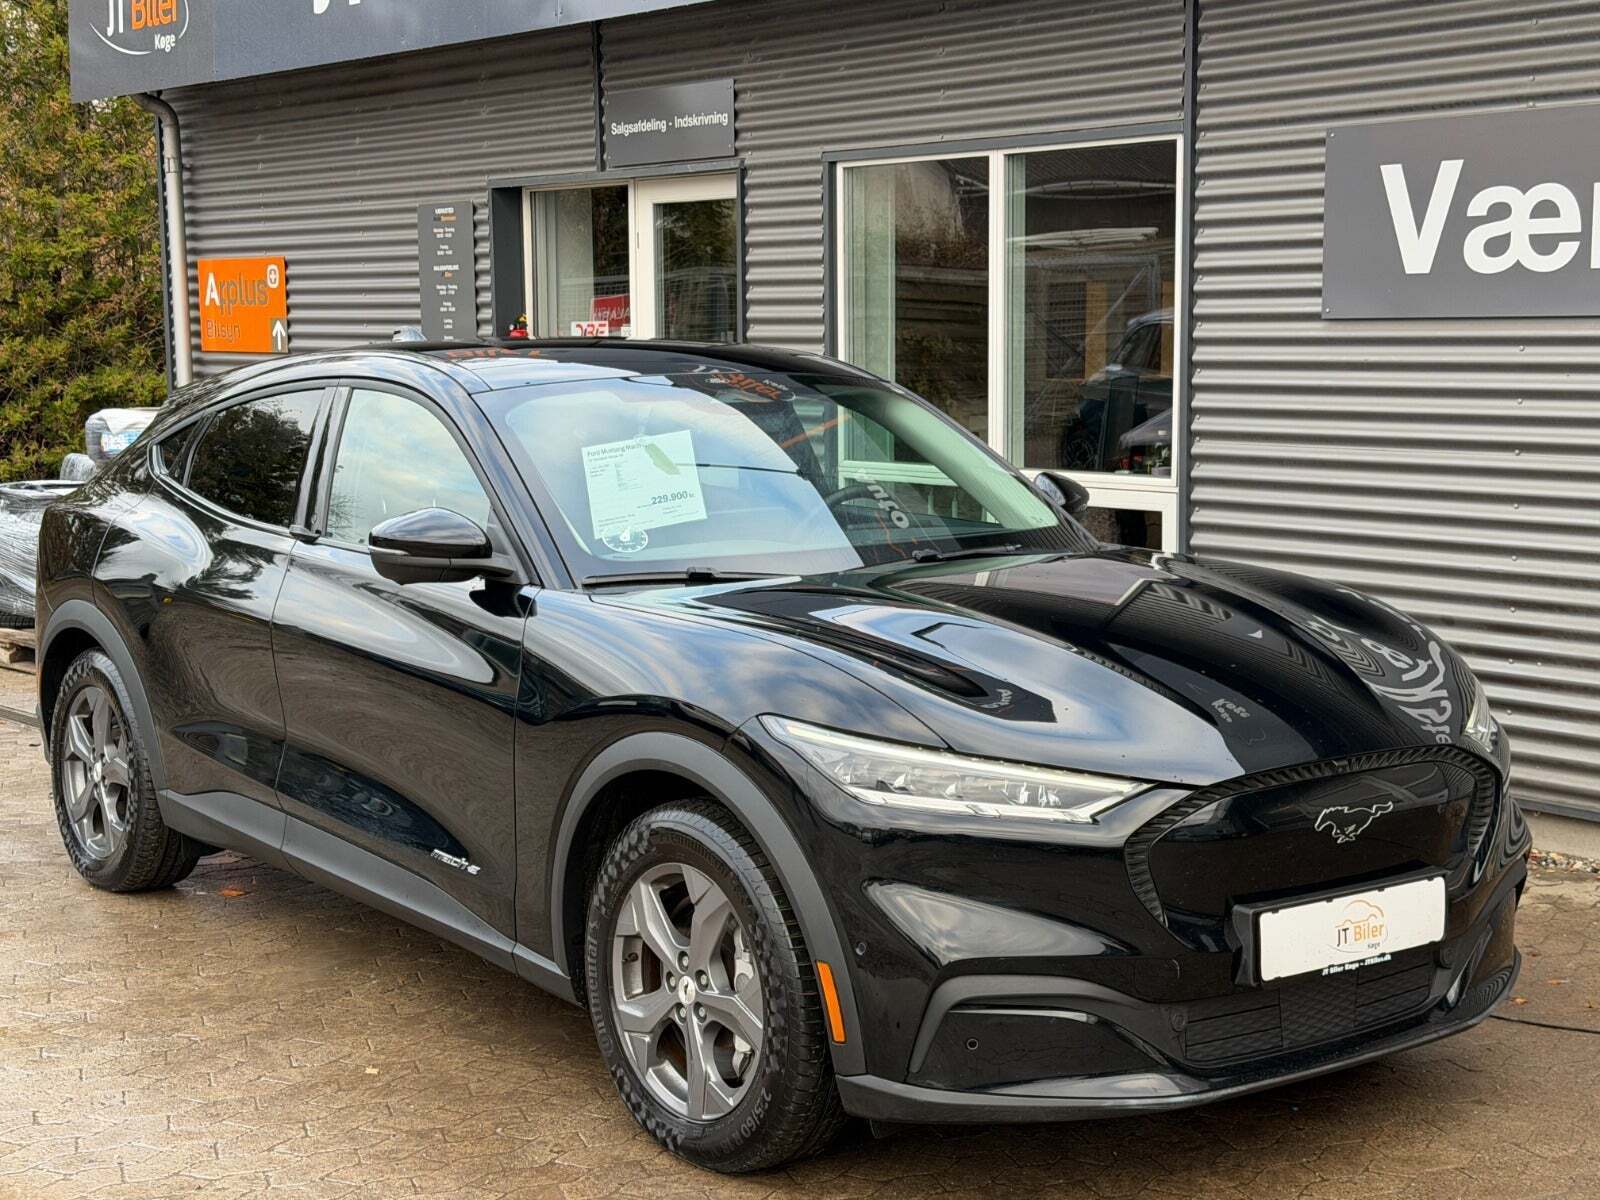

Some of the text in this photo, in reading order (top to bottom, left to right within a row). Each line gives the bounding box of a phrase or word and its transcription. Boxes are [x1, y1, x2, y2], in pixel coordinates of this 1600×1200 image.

[154, 33, 176, 53] Køge
[611, 118, 667, 137] Salgsafdeling
[674, 111, 729, 129] Indskrivning
[207, 319, 241, 343] Bilsyn
[651, 491, 689, 505] 229.900
[1336, 923, 1385, 948] JT Biler
